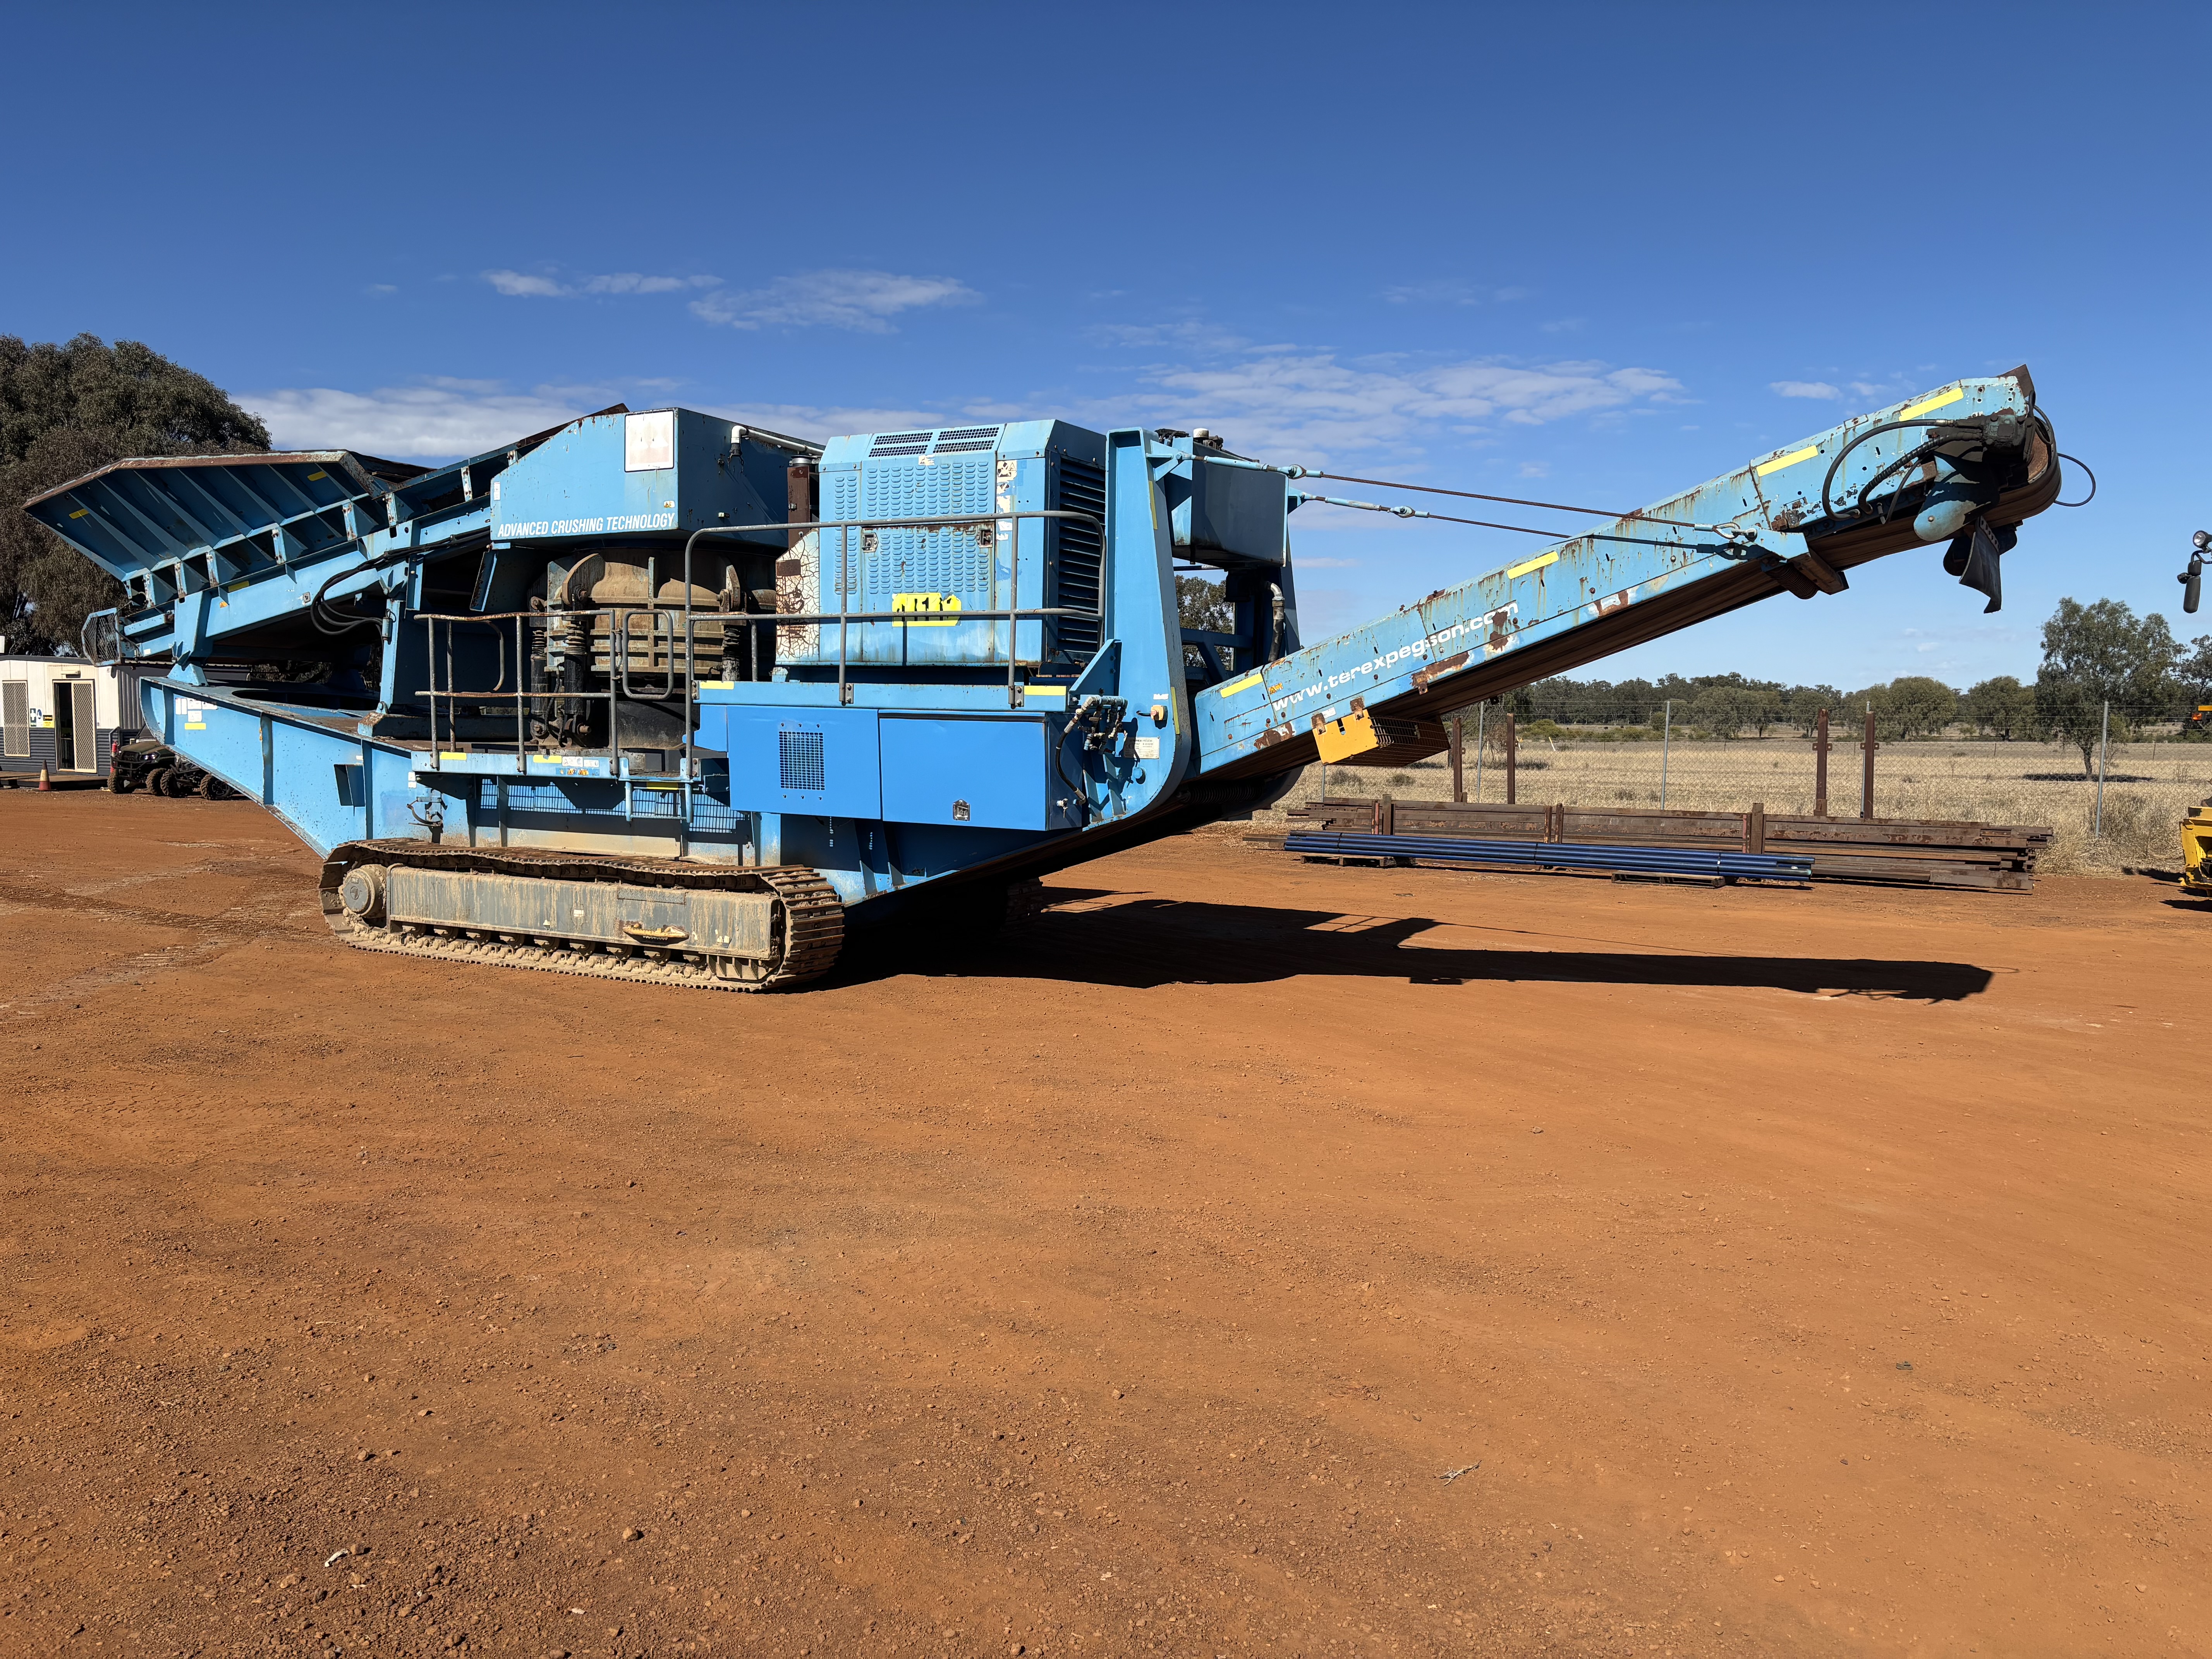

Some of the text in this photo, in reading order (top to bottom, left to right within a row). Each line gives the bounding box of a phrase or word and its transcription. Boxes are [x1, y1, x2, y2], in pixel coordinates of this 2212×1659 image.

[498, 513, 675, 537] ADVANCED CRUSHING TECHNOLOGY
[1272, 603, 1518, 711] www.terexpegson.com
